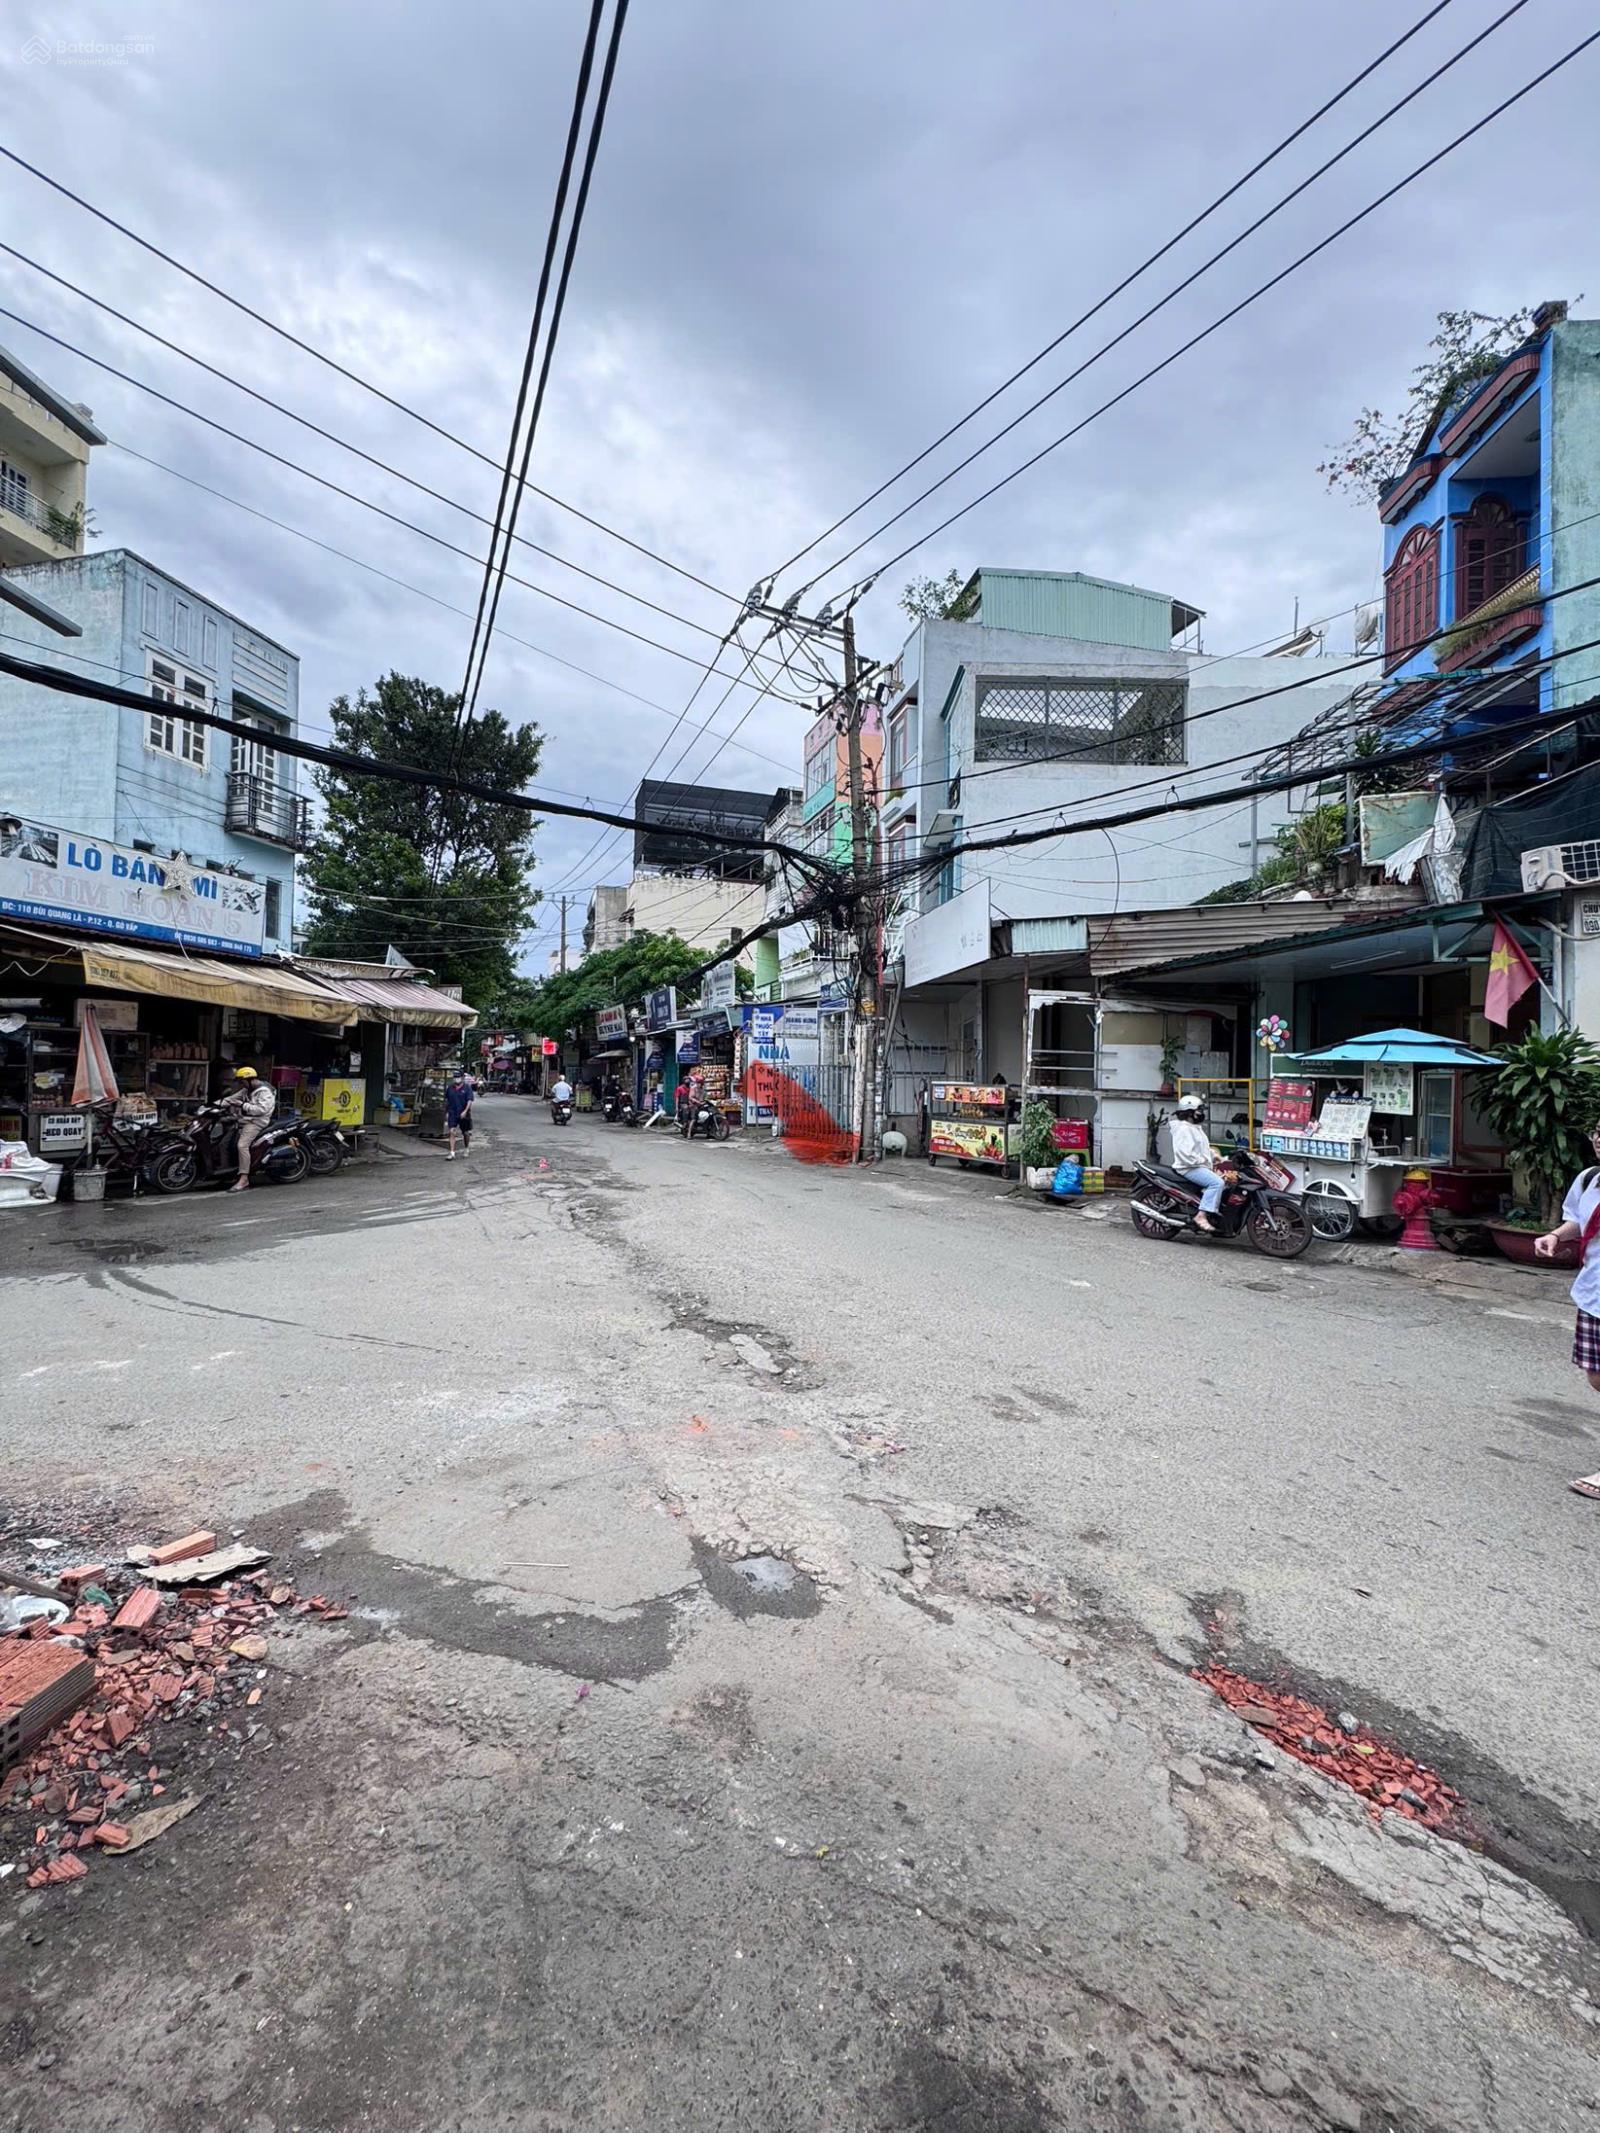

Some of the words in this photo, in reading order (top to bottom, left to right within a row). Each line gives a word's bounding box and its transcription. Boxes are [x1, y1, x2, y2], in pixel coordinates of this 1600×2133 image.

[68, 842, 102, 871] LÒ
[24, 868, 111, 910] KIM
[18, 904, 31, 914] 110
[47, 908, 72, 920] QUANG
[63, 1127, 82, 1136] QUAY
